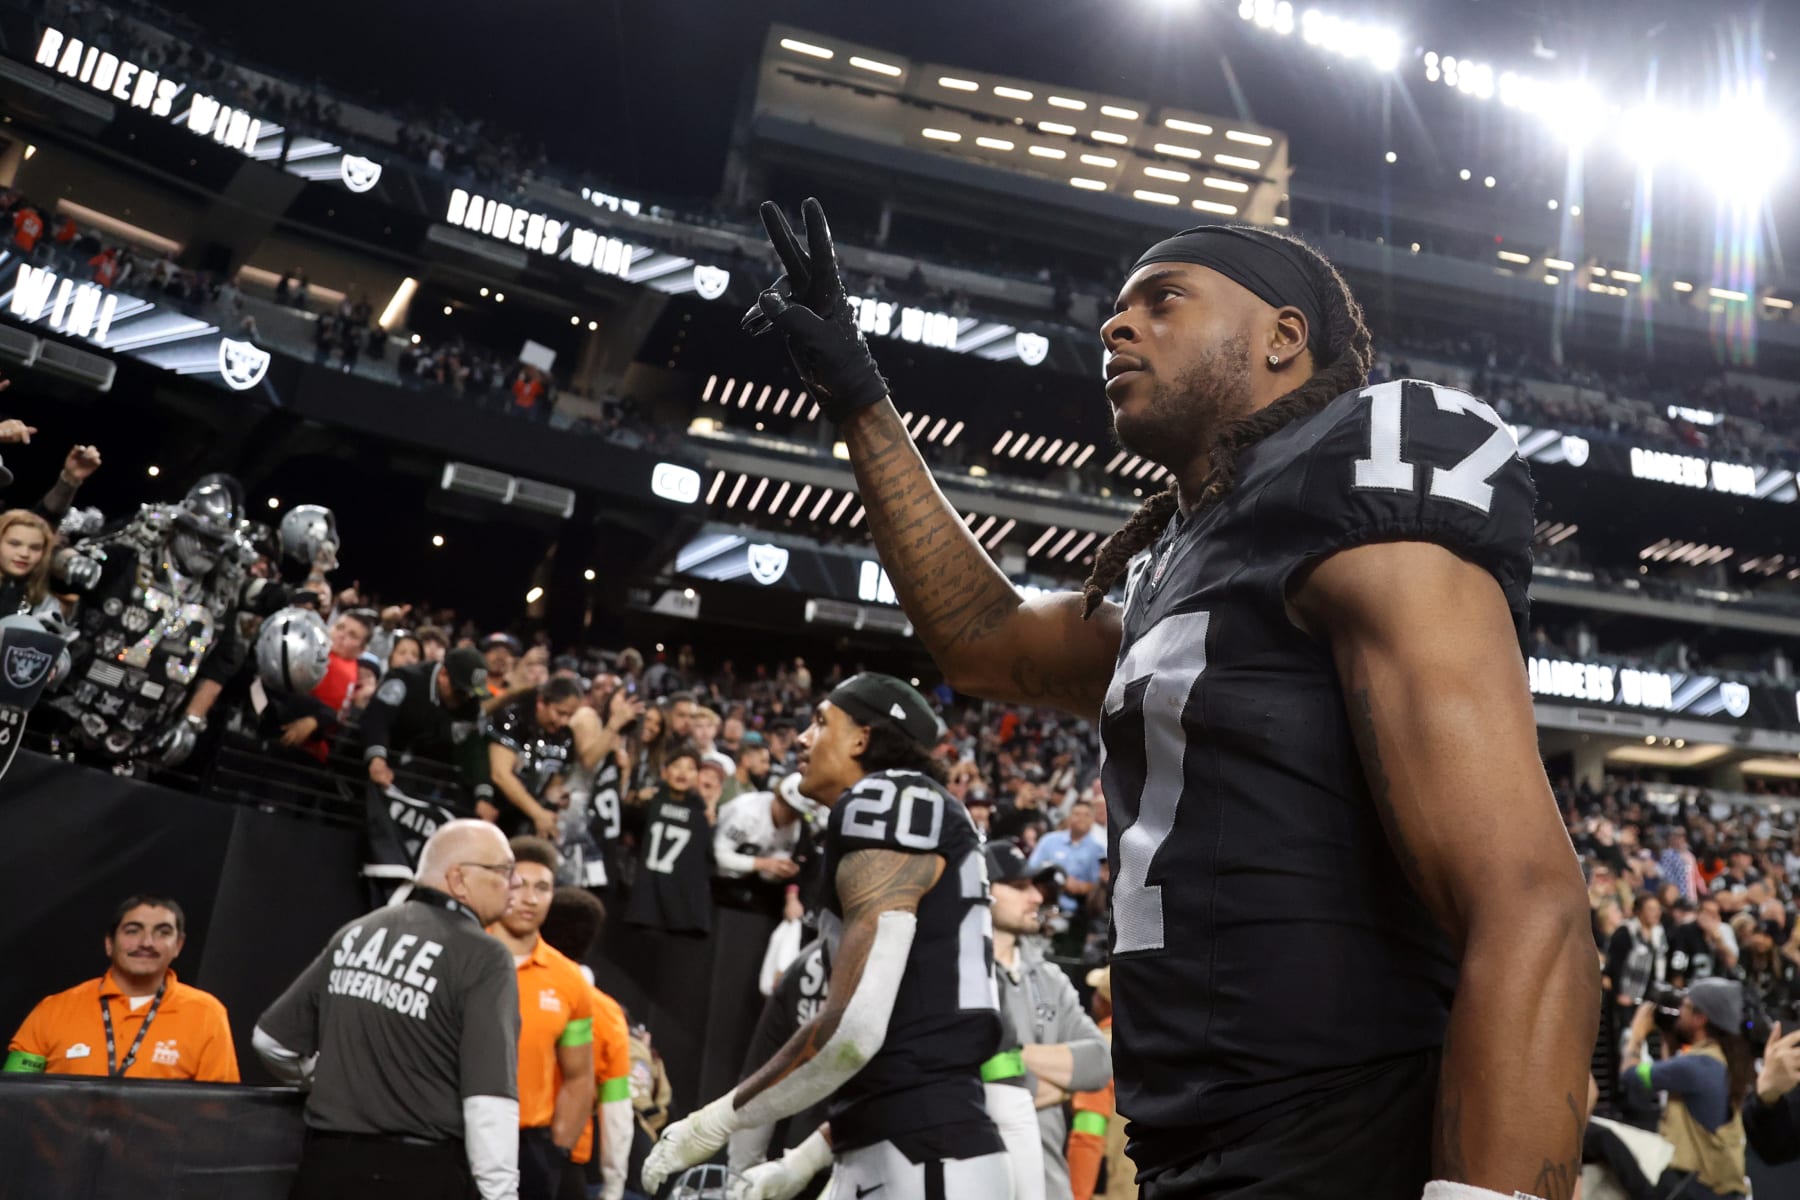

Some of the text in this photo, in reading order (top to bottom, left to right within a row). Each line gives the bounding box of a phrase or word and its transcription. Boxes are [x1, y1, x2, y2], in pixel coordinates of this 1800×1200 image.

[35, 27, 261, 154] RAIDERS WIN!
[446, 188, 562, 256] RAIDERS
[571, 228, 633, 278] WIN!
[10, 263, 118, 344] WIN!
[1354, 378, 1520, 513] 17
[1630, 447, 1708, 489] RAIDERS
[646, 821, 692, 874] 17
[841, 778, 944, 850] 20
[328, 968, 431, 1021] SUPERVISOR
[333, 925, 444, 993] S.A.F.E.
